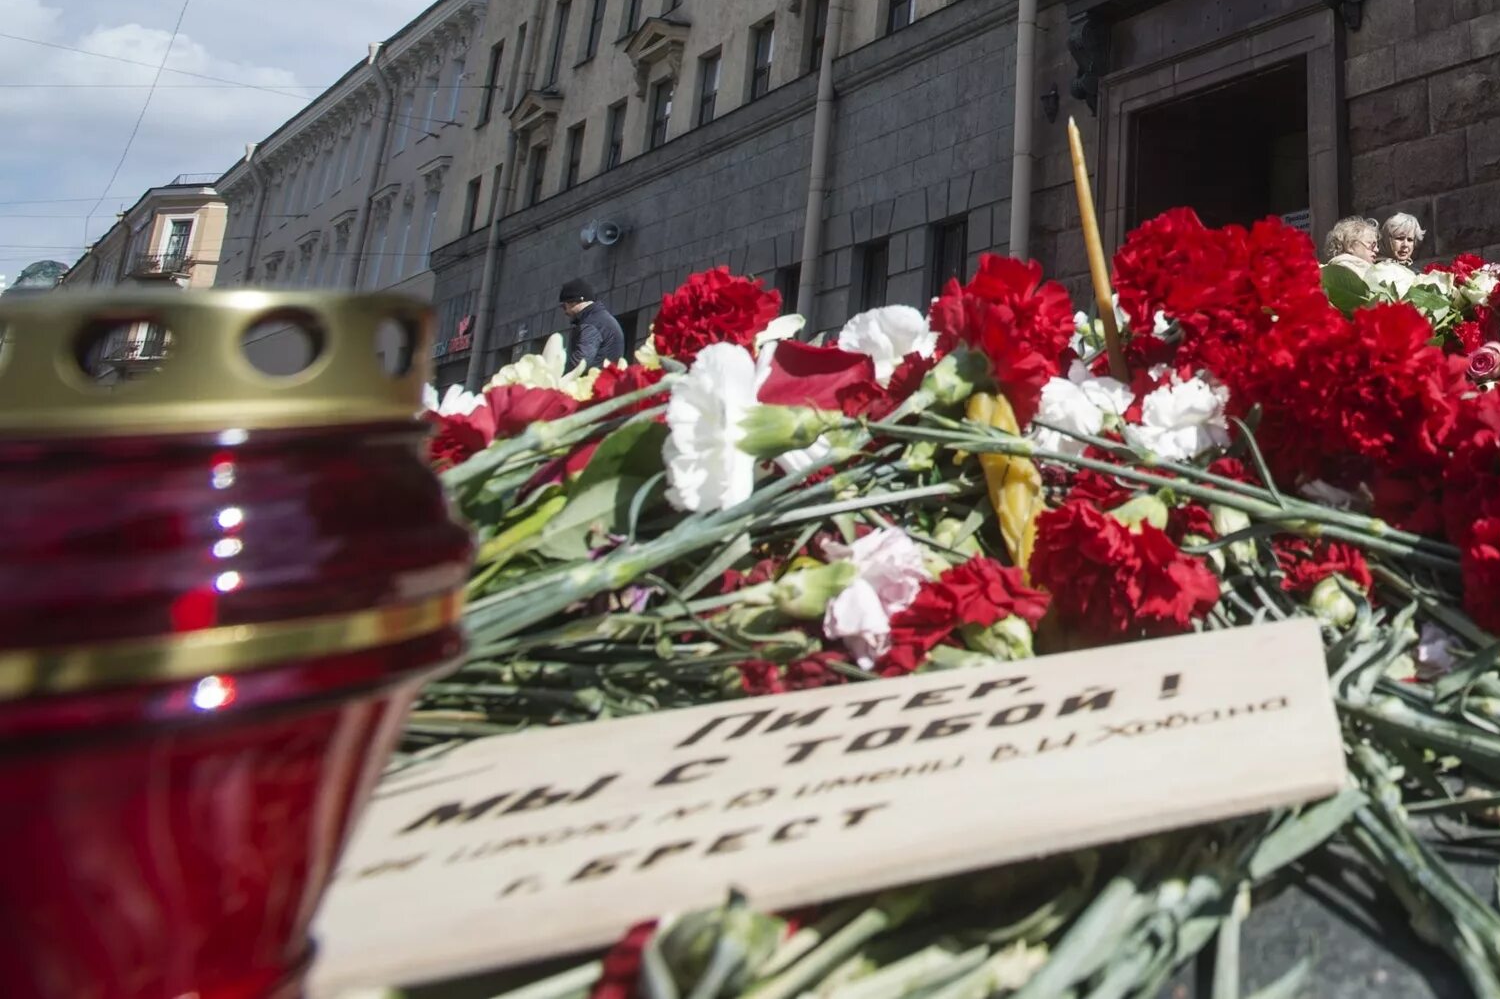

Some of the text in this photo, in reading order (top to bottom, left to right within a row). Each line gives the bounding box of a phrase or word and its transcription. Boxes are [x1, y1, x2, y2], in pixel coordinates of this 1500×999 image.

[393, 772, 622, 836] МЫ
[650, 756, 731, 789] С
[782, 686, 1118, 767] ТОБОЙ
[566, 800, 892, 885] БРЕСТ
